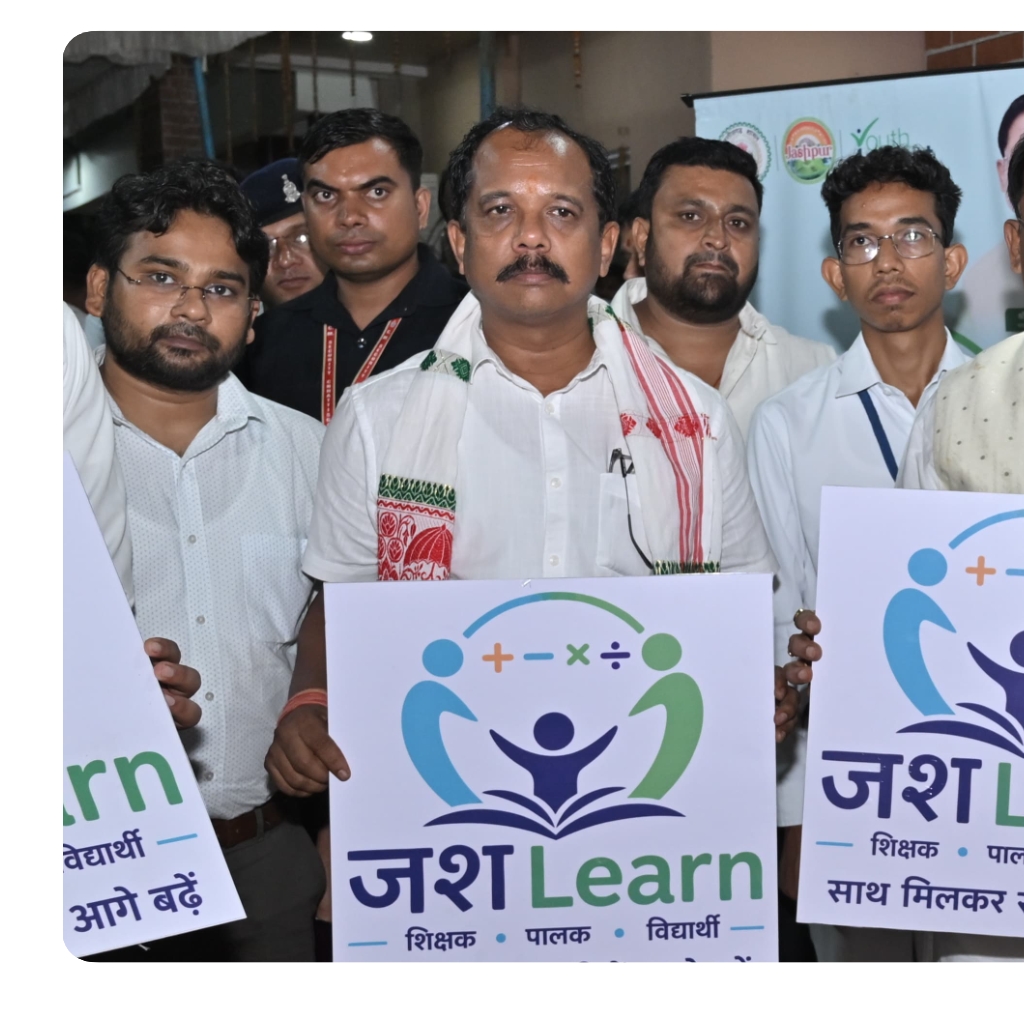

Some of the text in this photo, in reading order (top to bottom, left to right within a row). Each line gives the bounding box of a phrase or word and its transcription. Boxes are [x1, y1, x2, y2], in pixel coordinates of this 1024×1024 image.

[787, 144, 833, 162] Jashpur
[822, 749, 983, 824] जश
[870, 831, 940, 860] शिक्षक
[346, 843, 764, 914] जश Learn
[827, 879, 891, 907] साथ
[900, 875, 1007, 914] मिलकर
[69, 886, 142, 933] आगे
[404, 913, 721, 952] शिक्षक पालक विद्यार्थी
